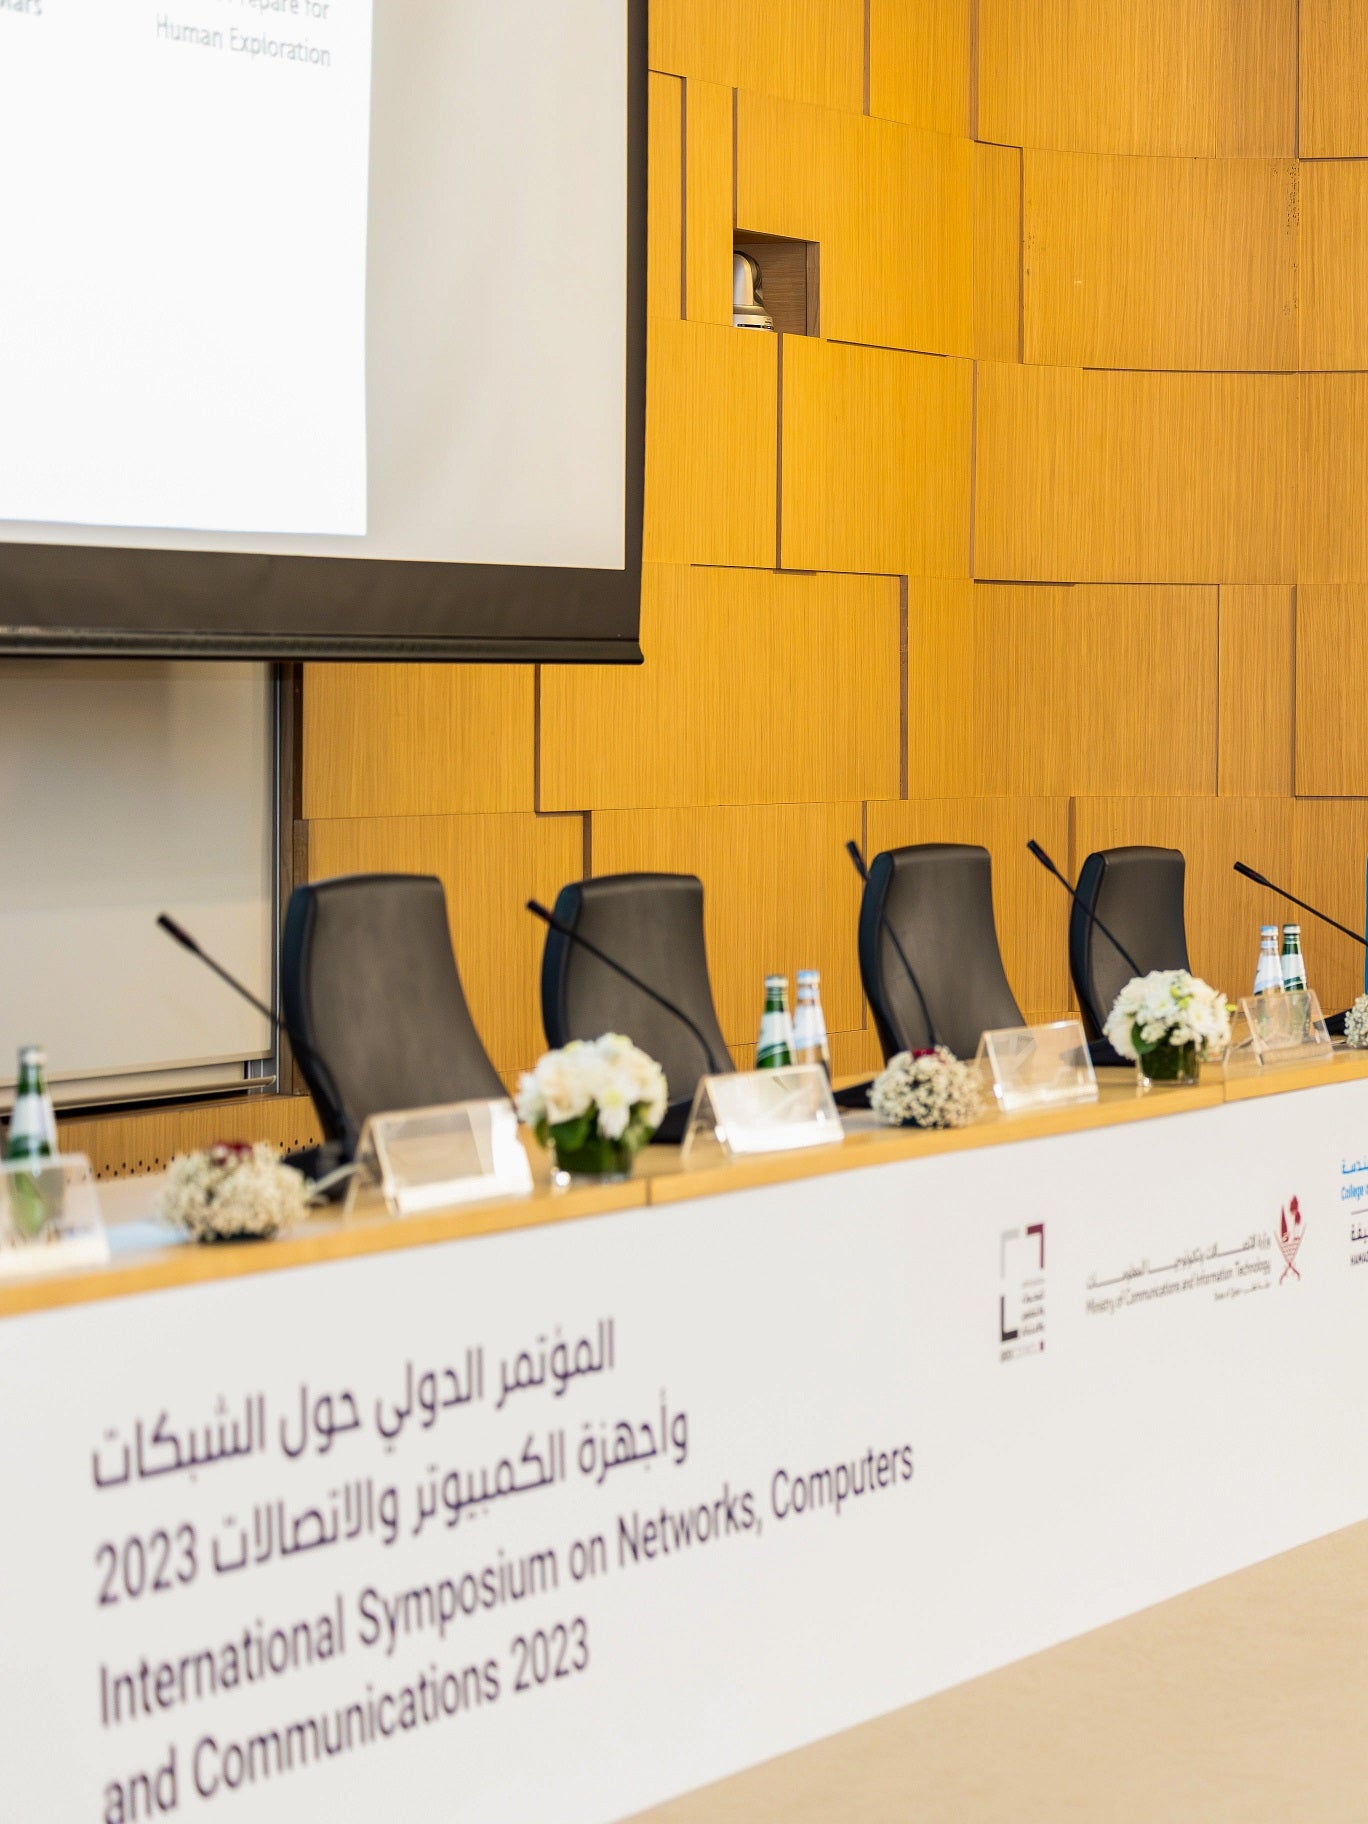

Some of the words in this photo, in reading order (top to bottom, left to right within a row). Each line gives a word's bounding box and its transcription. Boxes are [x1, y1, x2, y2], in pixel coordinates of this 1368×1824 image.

[156, 13, 223, 49] Human
[229, 27, 331, 67] Exploration
[1341, 1181, 1365, 1202] College
[374, 1345, 484, 1453] الدولي
[496, 1316, 614, 1409] المؤتمر
[92, 1391, 266, 1489] الشبكات
[279, 1382, 361, 1460] حول
[577, 1387, 688, 1484] وأجهزة
[211, 1476, 399, 1573] والاتصالات
[411, 1430, 566, 1536] الكمبيوتر
[95, 1521, 199, 1609] 2023
[98, 1592, 346, 1730] International
[358, 1548, 559, 1656] Symposium
[568, 1532, 608, 1583] on
[617, 1481, 764, 1569] Networks,
[771, 1443, 914, 1516] Computers
[103, 1742, 178, 1824] and
[192, 1658, 500, 1801] Communications
[511, 1615, 590, 1693] 2023
